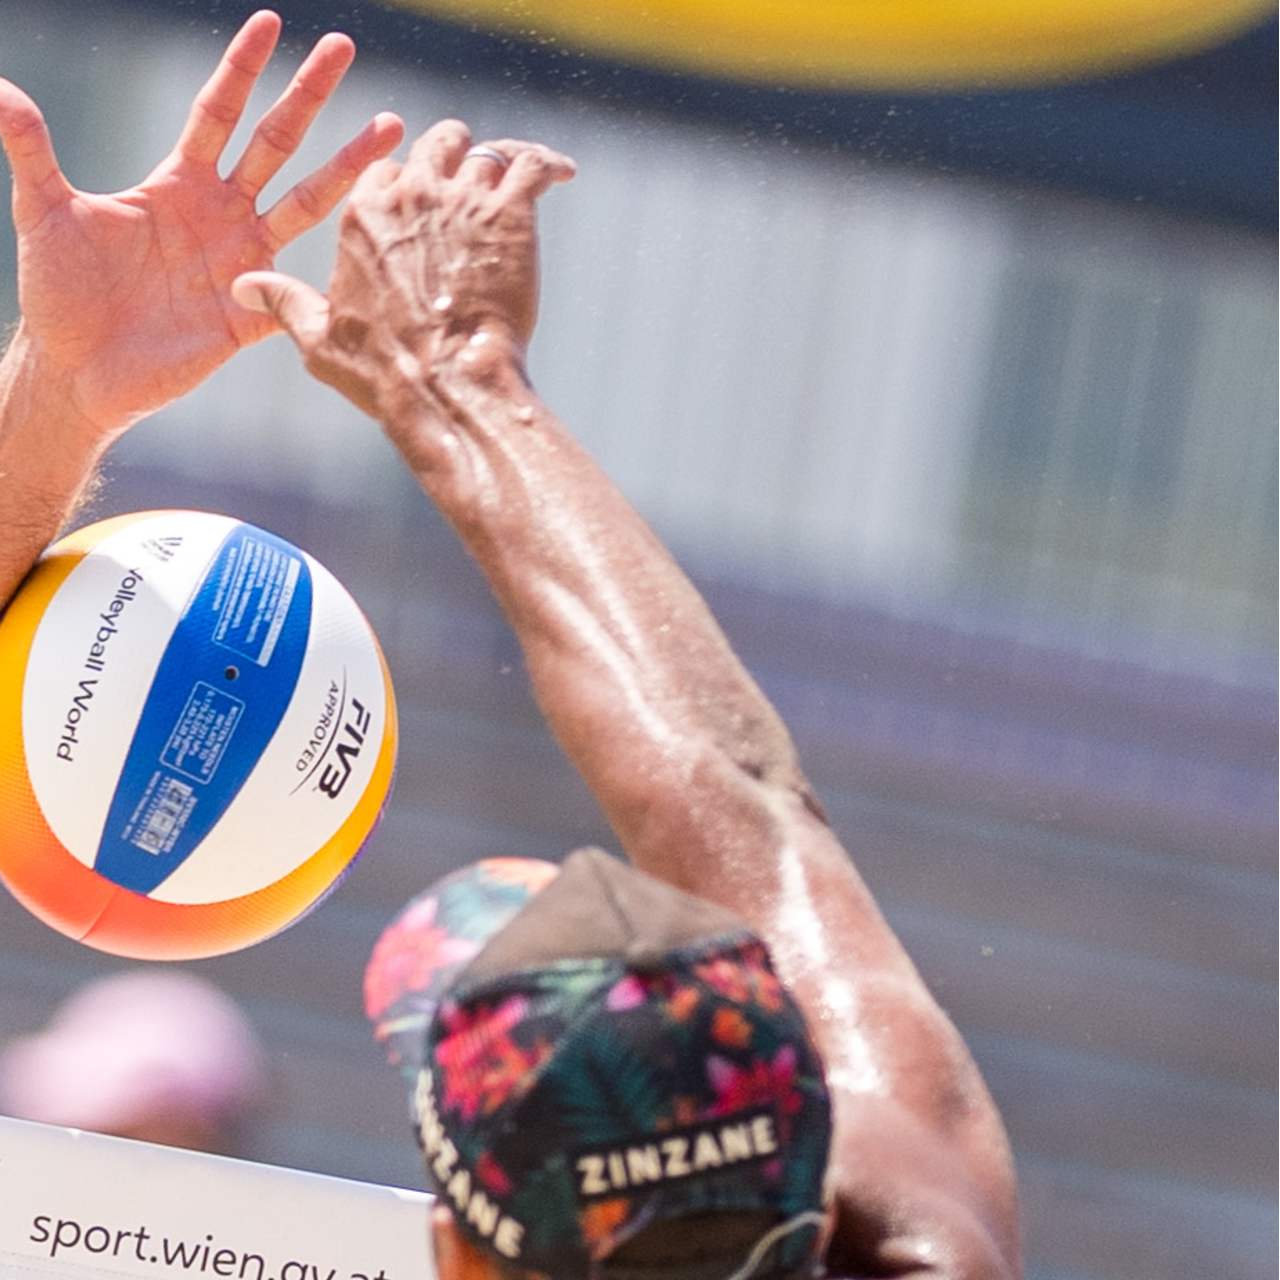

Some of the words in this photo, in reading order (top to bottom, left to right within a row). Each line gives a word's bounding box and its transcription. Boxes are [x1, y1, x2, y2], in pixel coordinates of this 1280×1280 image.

[83, 566, 144, 672] Volleyball
[56, 678, 99, 762] World
[295, 679, 339, 772] APPROVED
[414, 1068, 526, 1260] ZANE
[576, 1116, 779, 1195] ZINZANE
